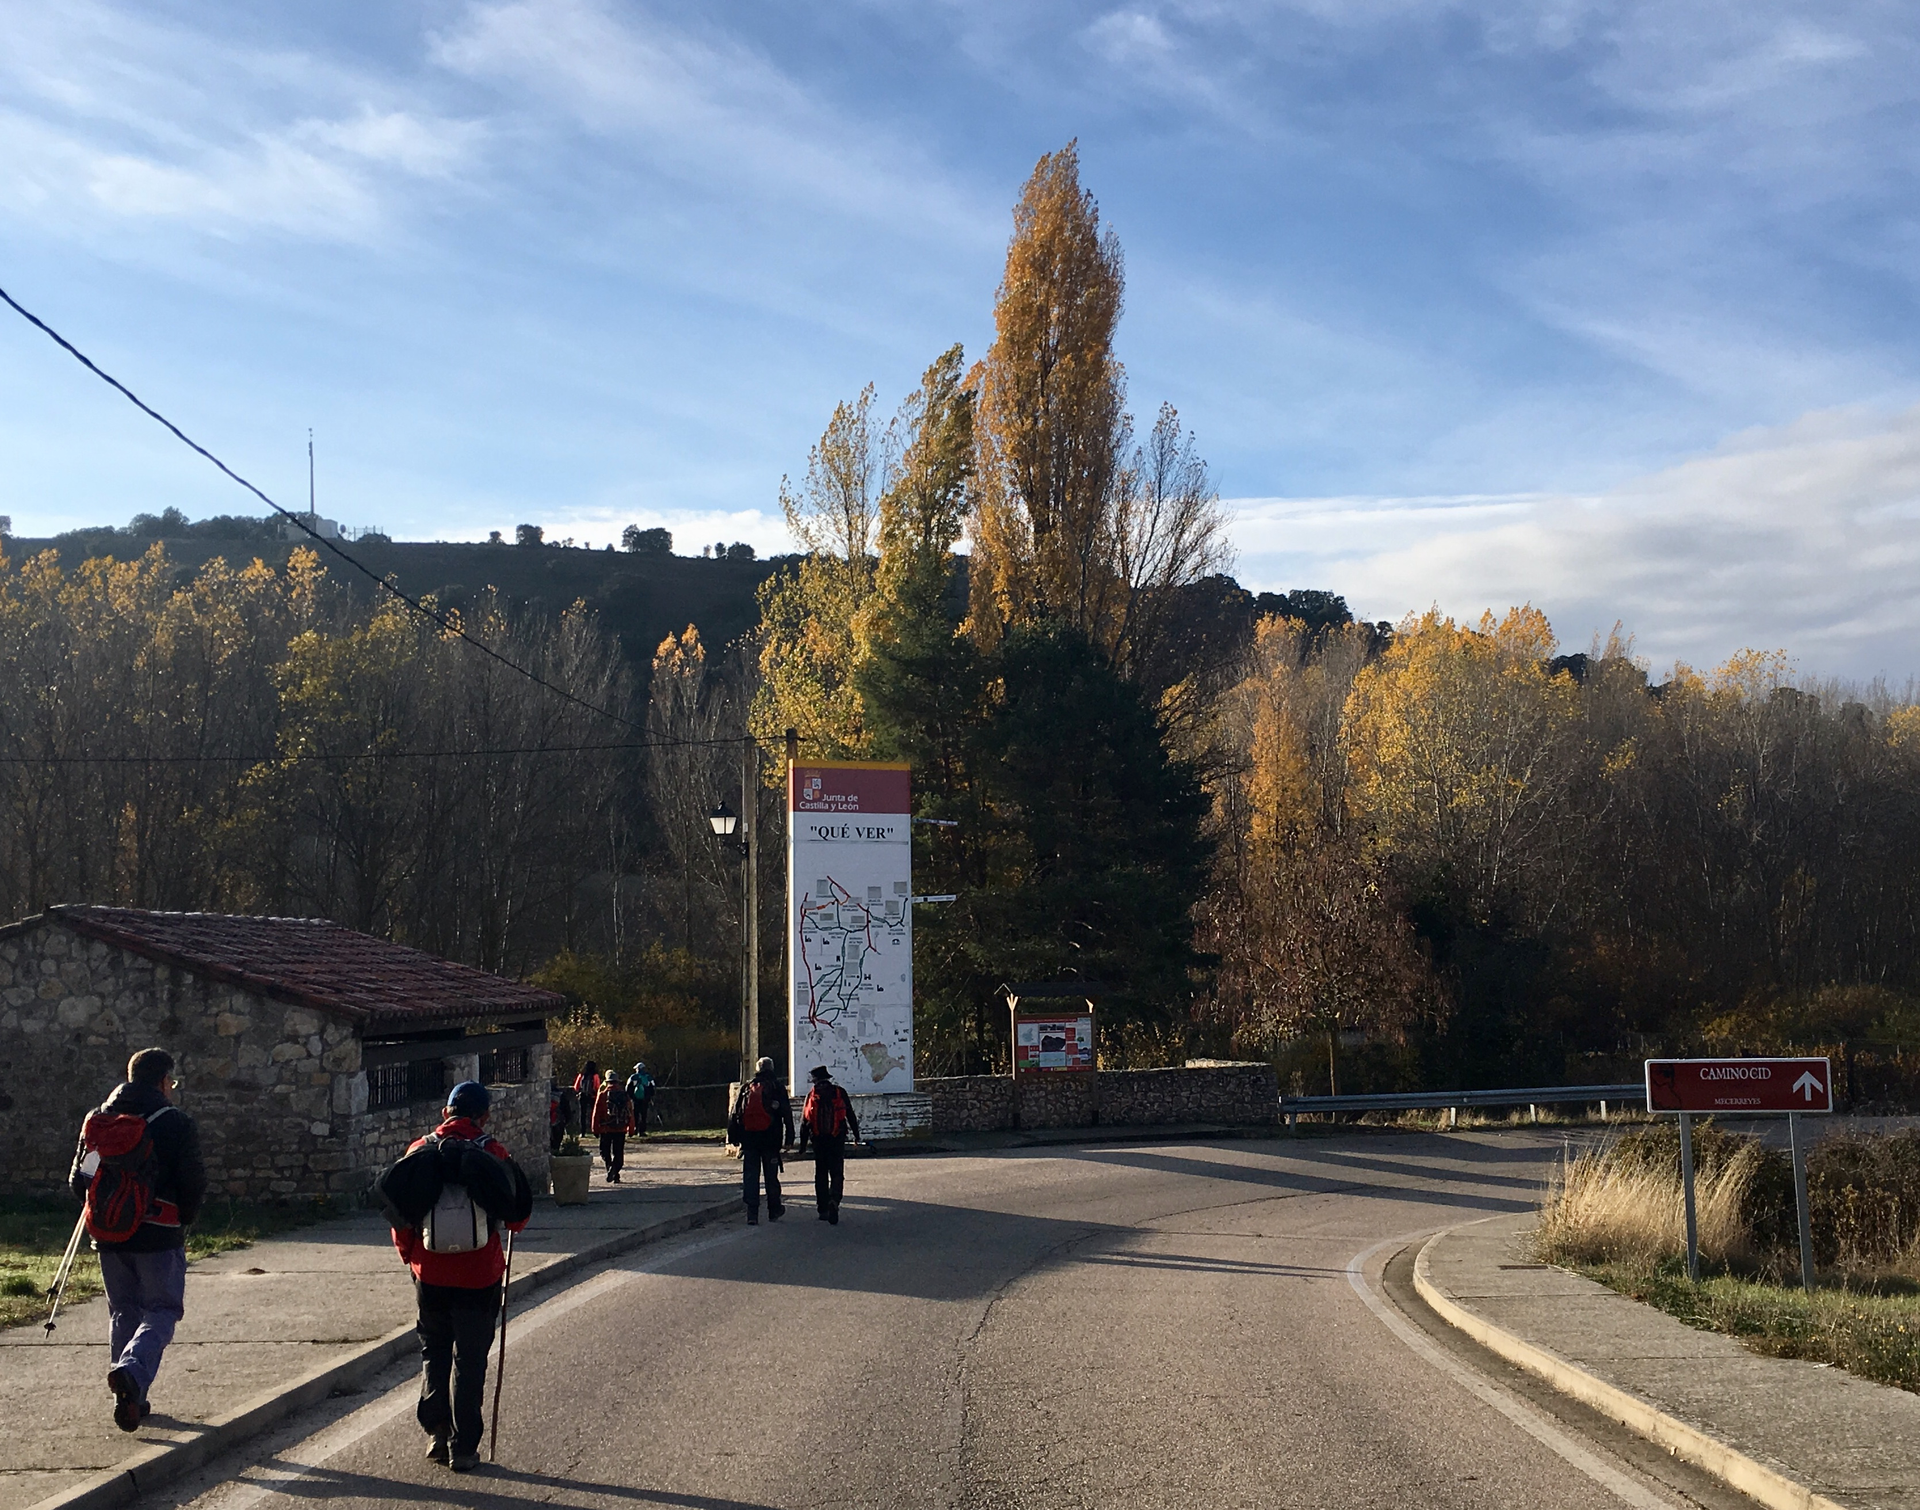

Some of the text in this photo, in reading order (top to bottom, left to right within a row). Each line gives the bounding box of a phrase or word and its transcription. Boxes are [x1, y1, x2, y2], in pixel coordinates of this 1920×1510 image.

[822, 794, 859, 802] Junta de
[799, 801, 859, 811] Castilla y León
[810, 824, 894, 840] "QUÉ VER"
[1700, 1068, 1771, 1080] CAMINO CID
